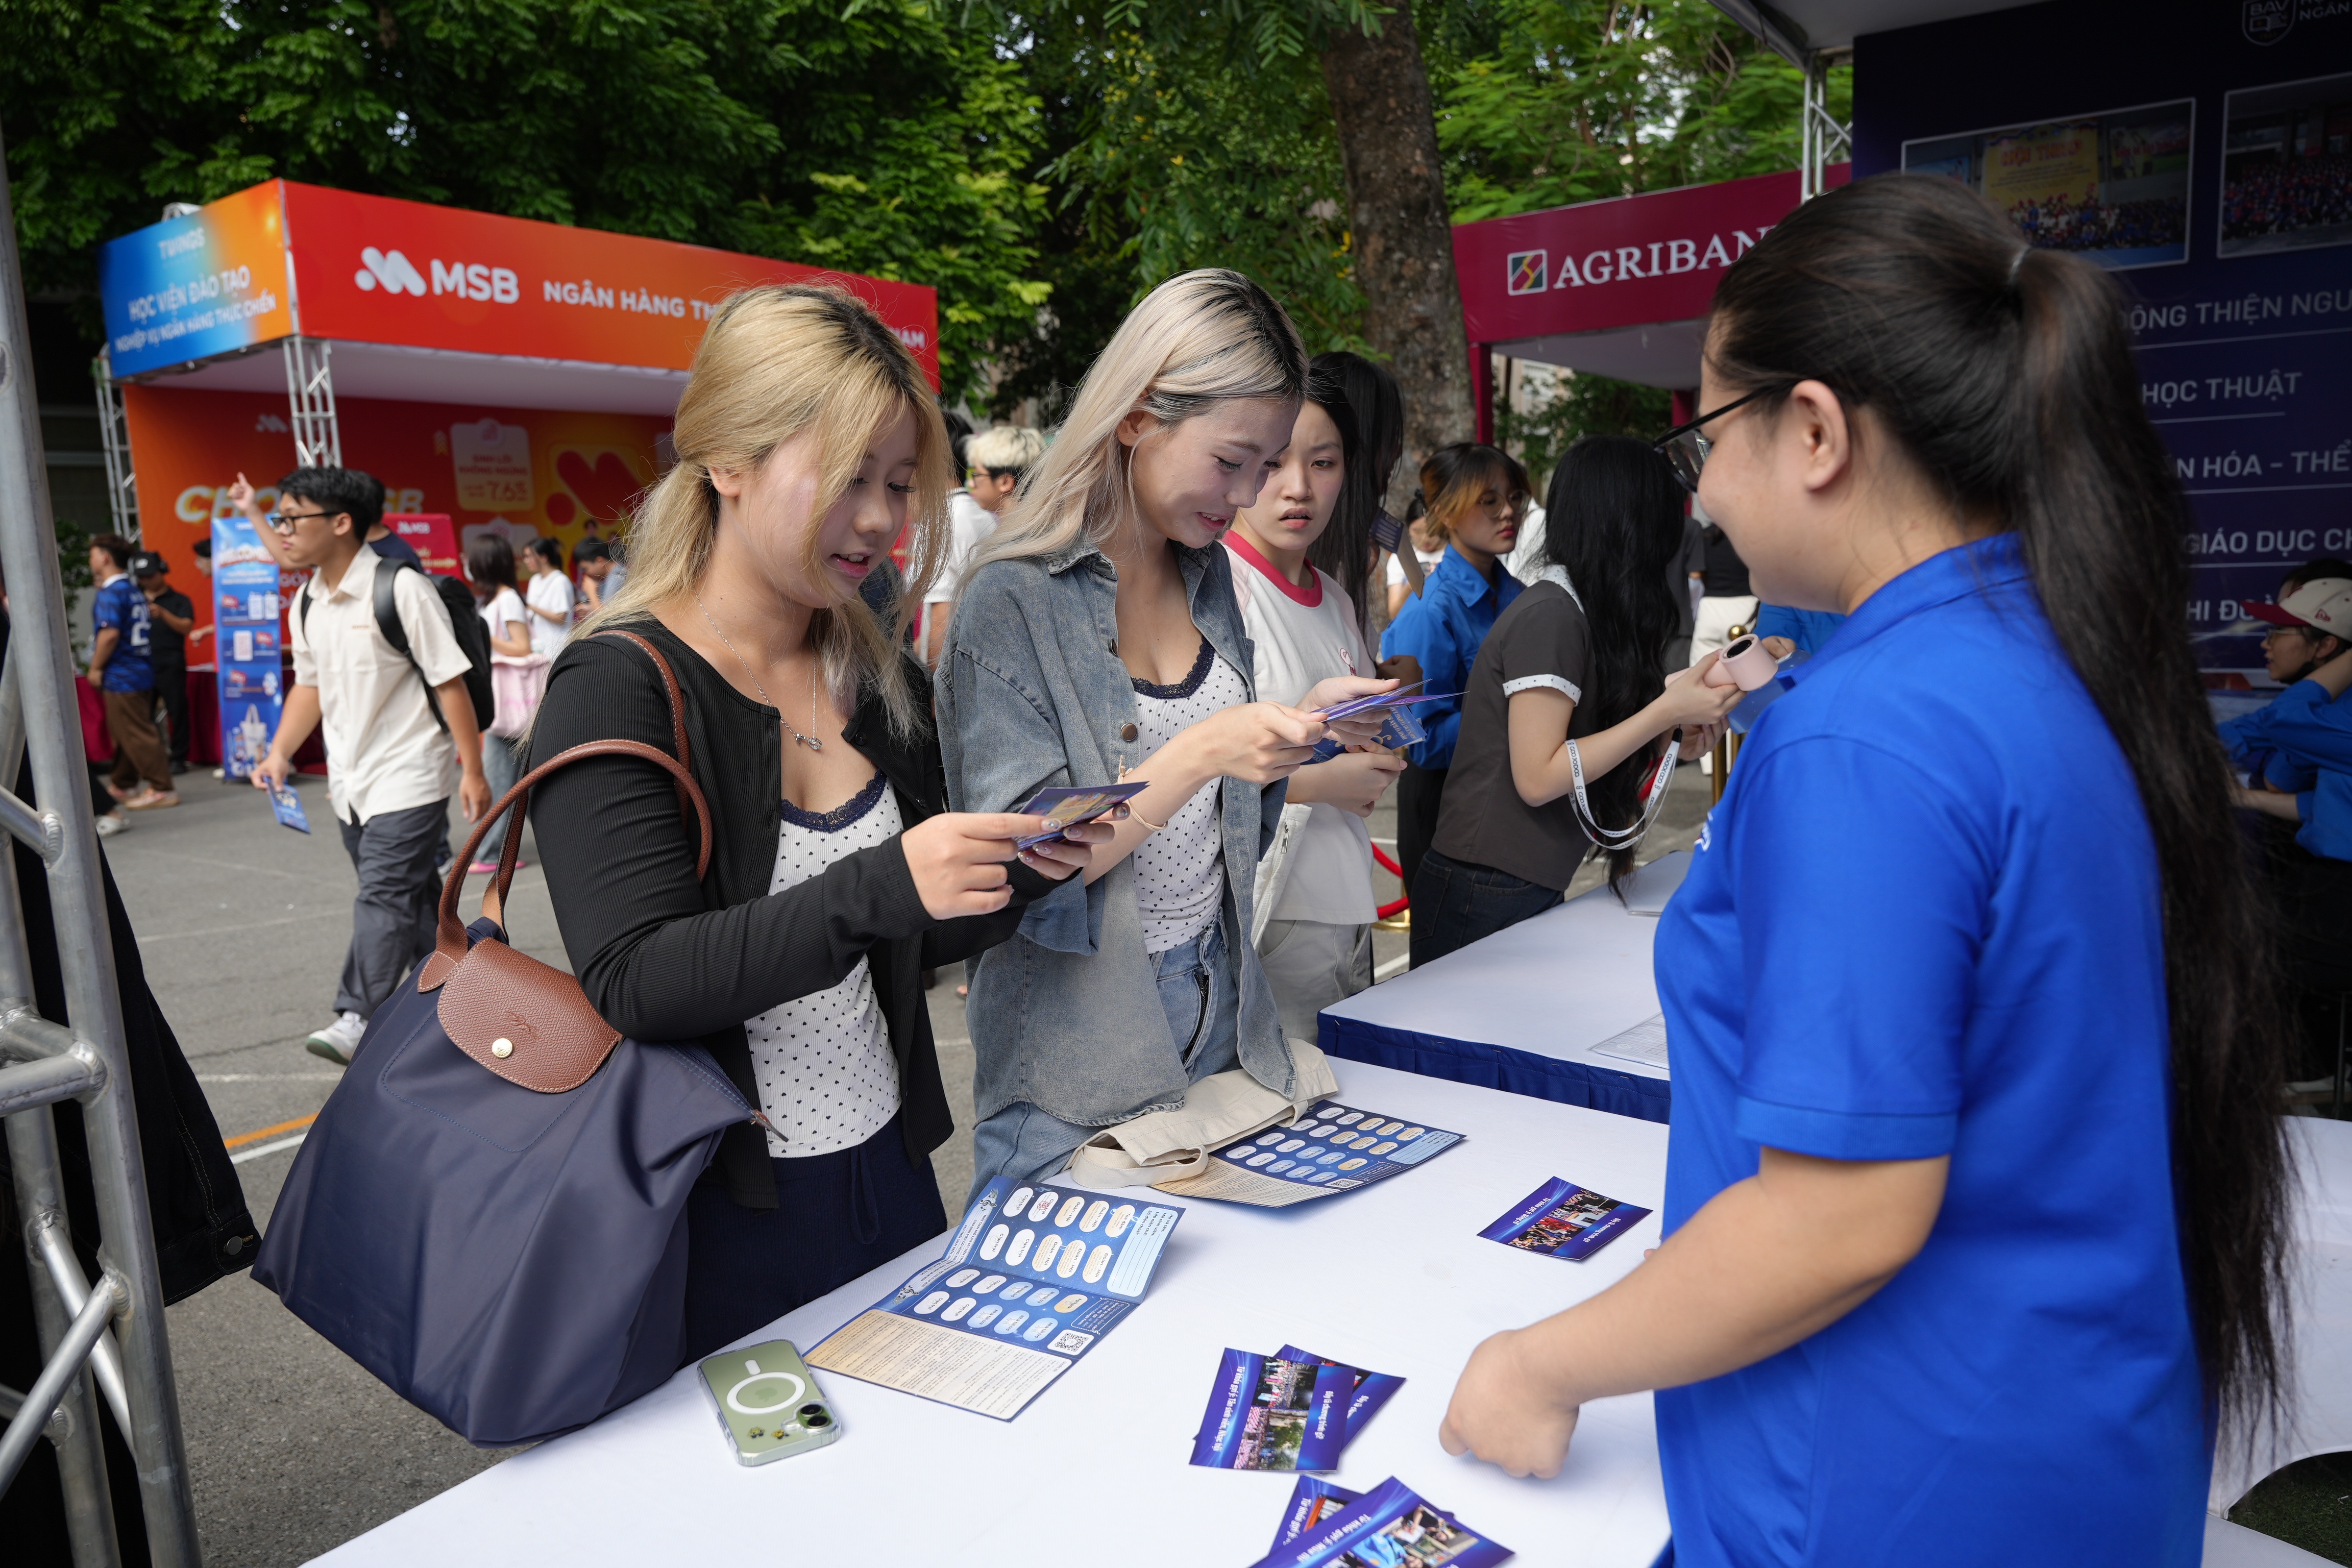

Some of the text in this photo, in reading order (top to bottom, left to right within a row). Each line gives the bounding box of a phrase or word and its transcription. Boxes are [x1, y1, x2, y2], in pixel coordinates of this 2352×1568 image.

[2250, 0, 2289, 17] BAV
[1552, 225, 1778, 289] AGRIBAN
[430, 258, 520, 304] MSB
[129, 265, 251, 325] HỌC VIỆN ĐÀO TẠO
[543, 279, 614, 309] NGÂN
[620, 286, 685, 318] HÀNG
[689, 299, 718, 322] TH
[2195, 292, 2283, 326] THIỆN
[2143, 368, 2302, 408] HỌC THUẬT
[2202, 450, 2263, 478] HÓA
[2290, 439, 2351, 474] THỂ
[2183, 527, 2248, 554] GIÁO
[2256, 529, 2317, 557] DỤC
[1072, 1202, 1081, 1212] Đoàn
[1097, 1207, 1107, 1217] Đoàn
[1074, 1248, 1083, 1261] Đoàn
[1100, 1253, 1109, 1265] Đoàn
[1233, 1373, 1244, 1384] khóa
[1230, 1384, 1239, 1393] gợi
[1323, 1391, 1334, 1399] Đây
[1227, 1398, 1236, 1407] Tân
[1223, 1407, 1233, 1417] sinh
[1318, 1403, 1331, 1420] chương
[1219, 1418, 1230, 1430] viên,
[1317, 1420, 1327, 1432] trình
[1215, 1430, 1227, 1442] Nhạc
[1315, 1431, 1325, 1439] gì?
[1212, 1442, 1223, 1452] hội
[1301, 1498, 1312, 1508] Từ
[1294, 1506, 1308, 1522] khóa
[1359, 1514, 1372, 1524] Từ
[1289, 1520, 1301, 1534] gợi
[1342, 1520, 1362, 1533] khóa
[1330, 1529, 1344, 1542] gợi
[1308, 1542, 1327, 1555] Mùa
[1297, 1552, 1311, 1564] thi
